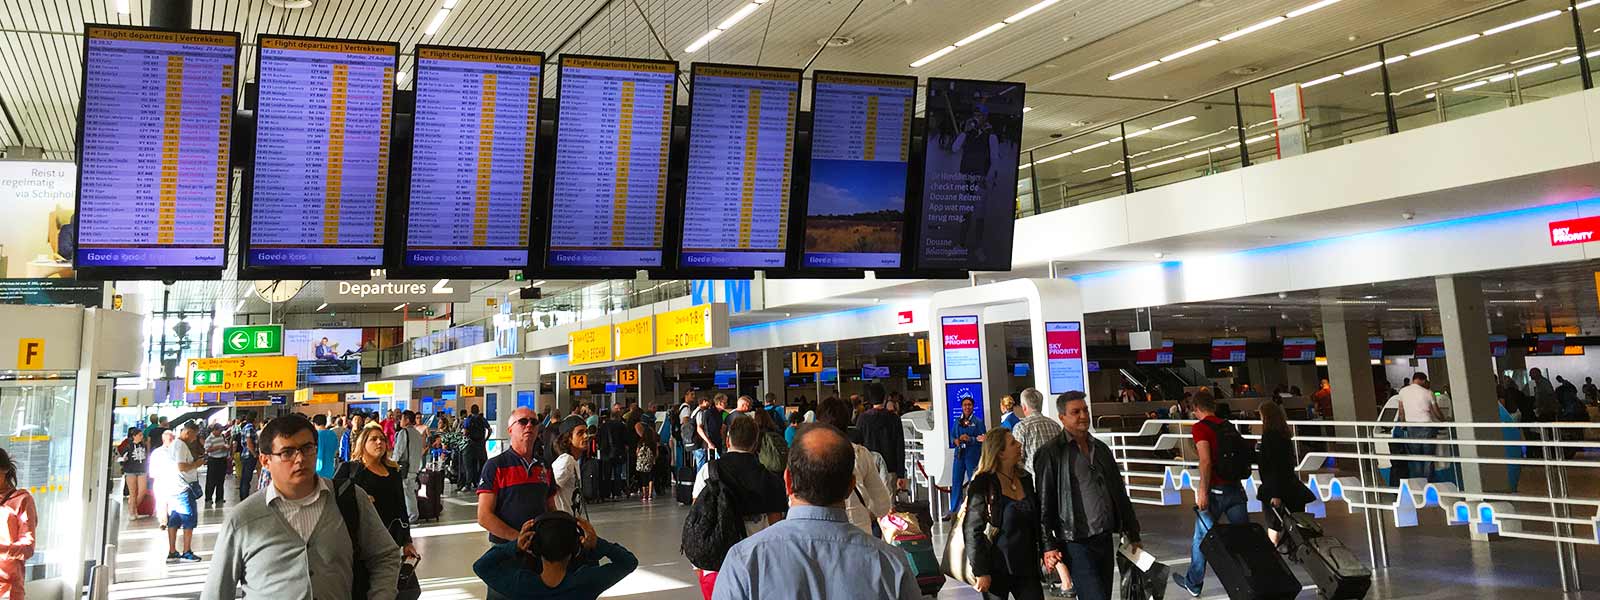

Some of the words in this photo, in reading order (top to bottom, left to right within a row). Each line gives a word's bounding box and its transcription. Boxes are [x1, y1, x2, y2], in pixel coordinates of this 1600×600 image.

[103, 30, 127, 41] Flight
[128, 32, 173, 43] departures
[180, 34, 224, 44] Vertrekken
[274, 40, 296, 50] Flight
[298, 42, 338, 51] departures
[345, 44, 385, 53] Vertrekken
[429, 51, 450, 60] Flight
[451, 52, 489, 61] departures
[494, 54, 531, 63] Vertrekken
[31, 168, 56, 178] Reist
[58, 170, 65, 178] u
[1, 179, 55, 189] regelmatig
[15, 190, 30, 198] via
[32, 190, 74, 201] Schiphol
[930, 193, 957, 201] Douane
[958, 193, 981, 201] Reizen
[928, 203, 943, 212] App
[928, 214, 948, 222] terug
[1552, 227, 1570, 235] SKY
[926, 238, 952, 246] Douane
[1553, 231, 1592, 243] PRIORITY
[338, 281, 427, 298] Departures
[25, 342, 39, 365] F
[239, 359, 246, 368] 3
[801, 353, 819, 368] 12
[233, 370, 258, 379] 17-32
[622, 370, 635, 381] 13
[224, 382, 231, 390] D
[572, 376, 584, 386] 14
